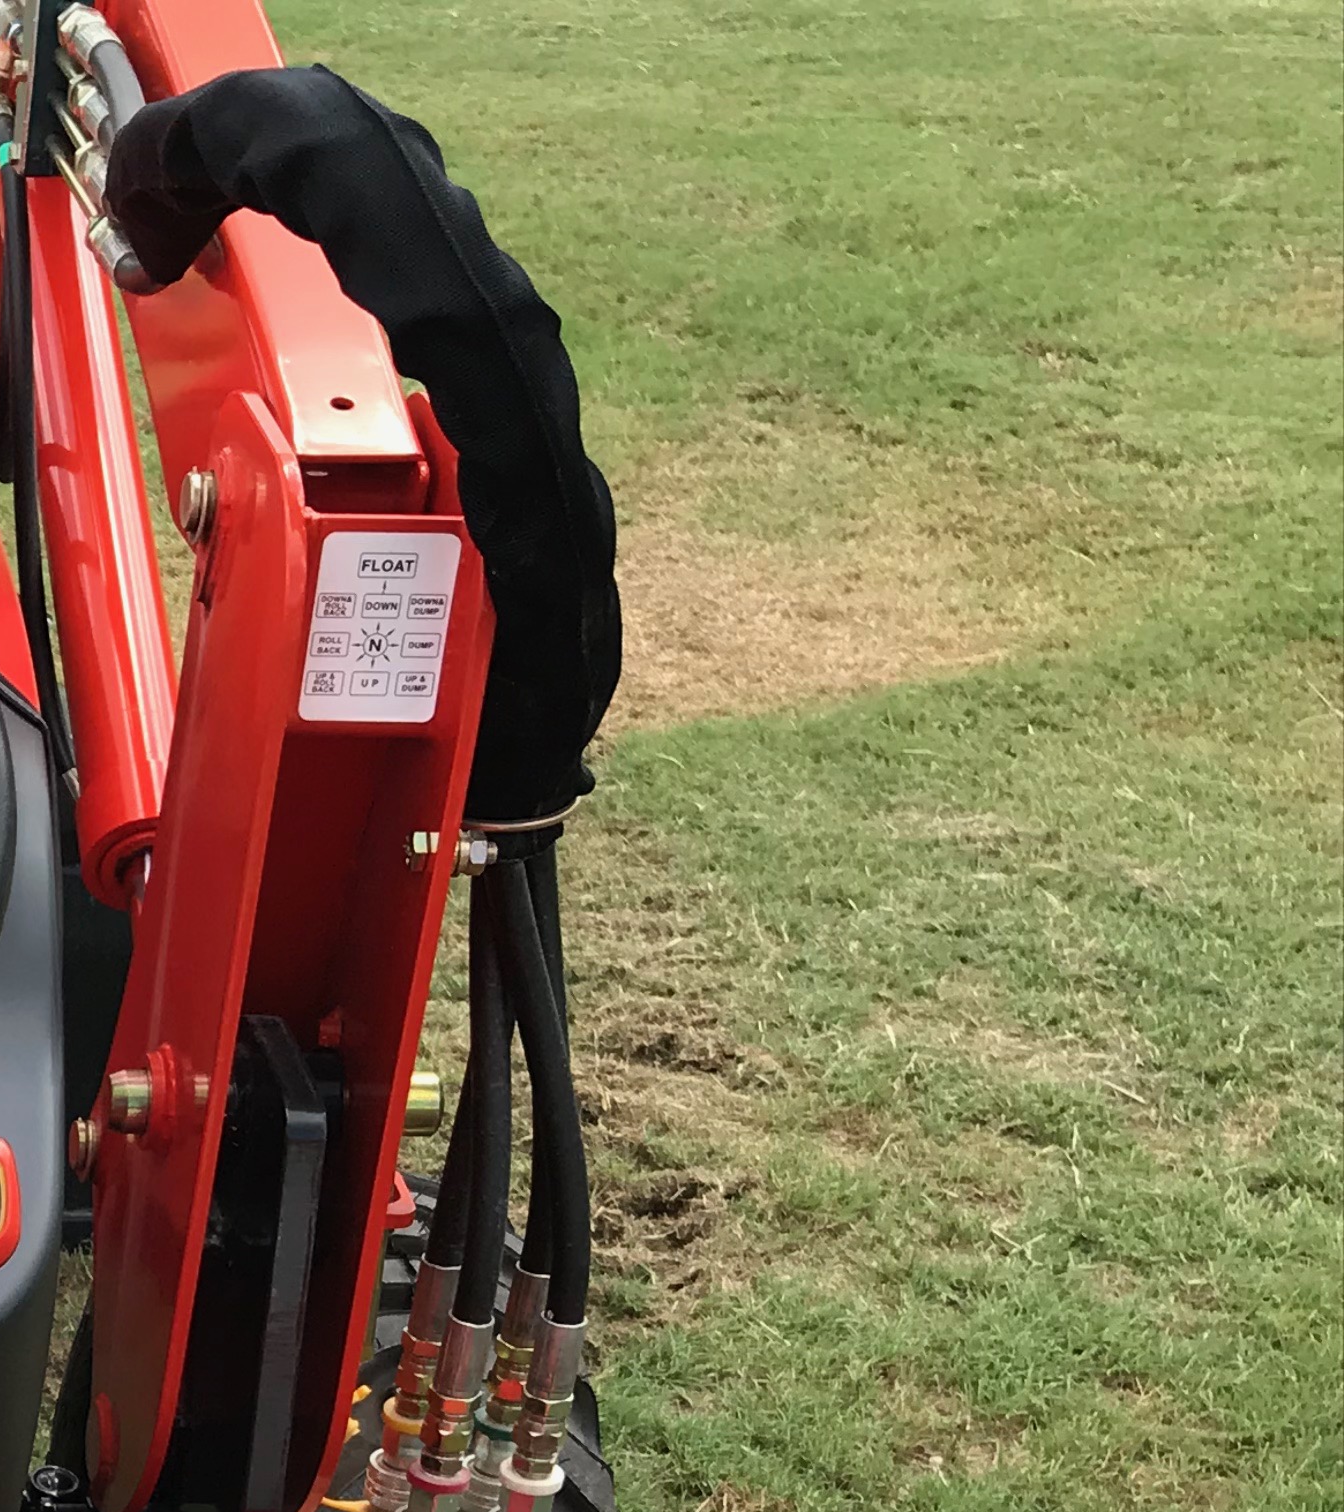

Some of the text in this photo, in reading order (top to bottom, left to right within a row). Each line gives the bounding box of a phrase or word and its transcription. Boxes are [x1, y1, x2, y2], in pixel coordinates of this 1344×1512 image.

[361, 559, 415, 573] FLOAT
[365, 601, 398, 611] DOWN
[413, 607, 440, 616] DUMP
[318, 636, 343, 645] ROLL
[368, 638, 382, 652] N
[407, 641, 434, 650] DUMP
[316, 646, 342, 655] BACK
[405, 675, 418, 683] UP
[401, 684, 428, 692] DUMP
